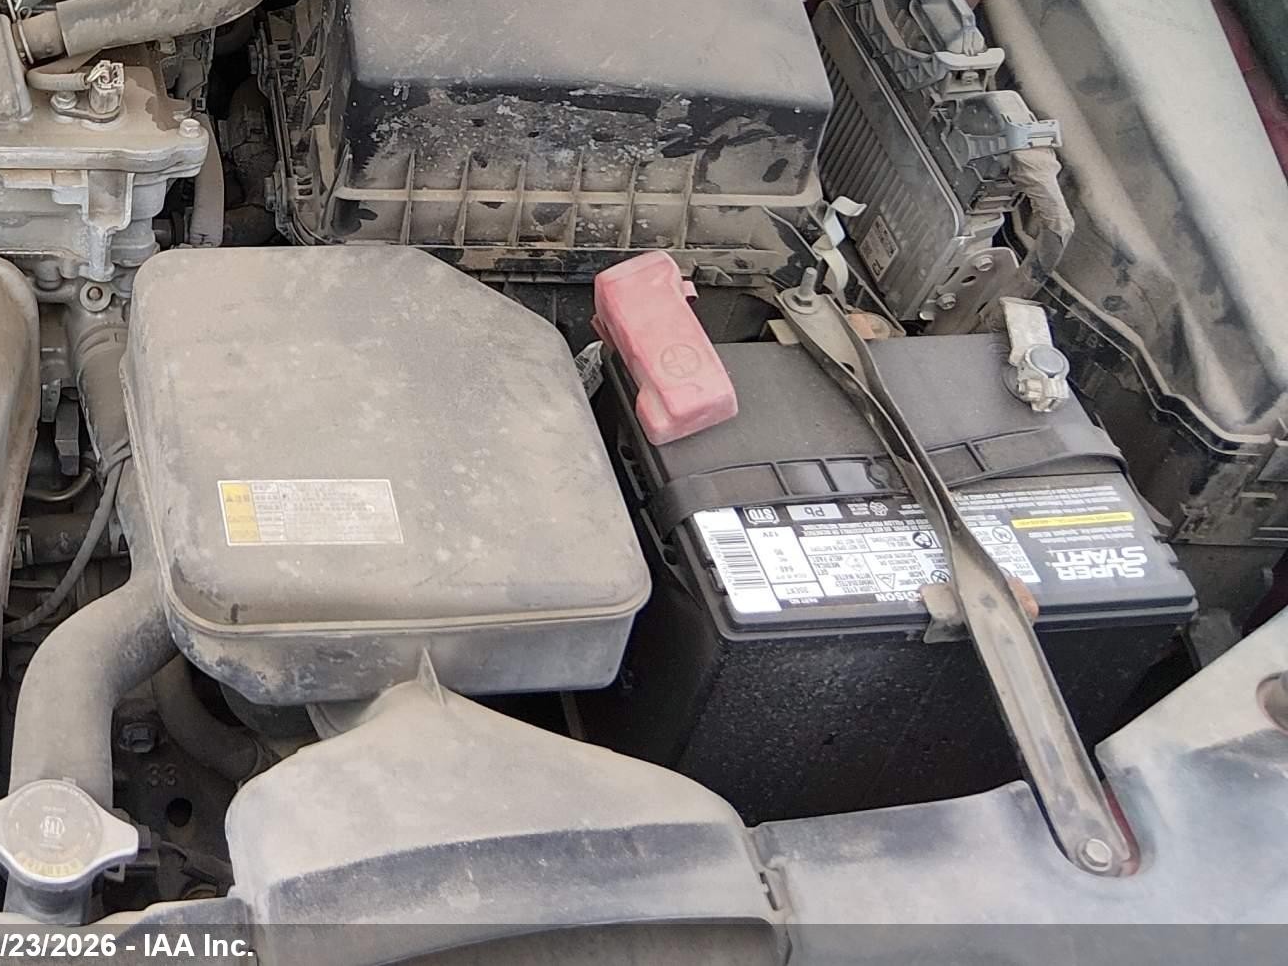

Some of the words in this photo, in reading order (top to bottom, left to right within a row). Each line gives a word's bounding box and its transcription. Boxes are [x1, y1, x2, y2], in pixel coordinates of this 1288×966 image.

[748, 508, 774, 518] STD
[804, 507, 824, 517] Pb
[1057, 563, 1145, 580] SUPER
